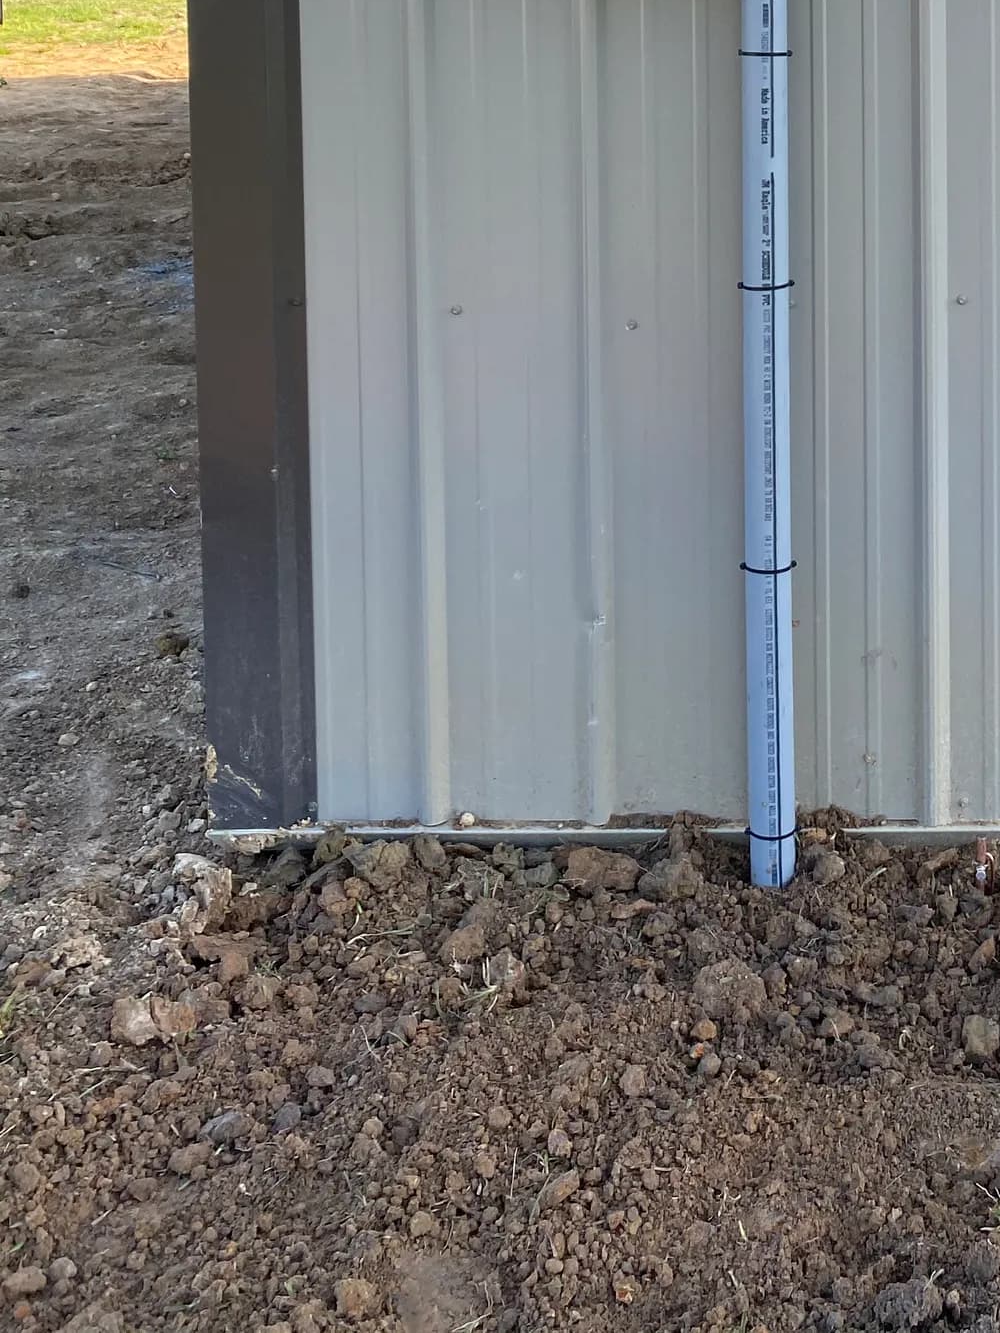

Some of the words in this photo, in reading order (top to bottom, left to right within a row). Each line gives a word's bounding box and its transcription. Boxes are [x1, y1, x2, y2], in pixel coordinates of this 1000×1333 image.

[761, 88, 770, 104] Made
[761, 107, 769, 115] in
[761, 117, 770, 144] America
[761, 190, 770, 210] Eagle
